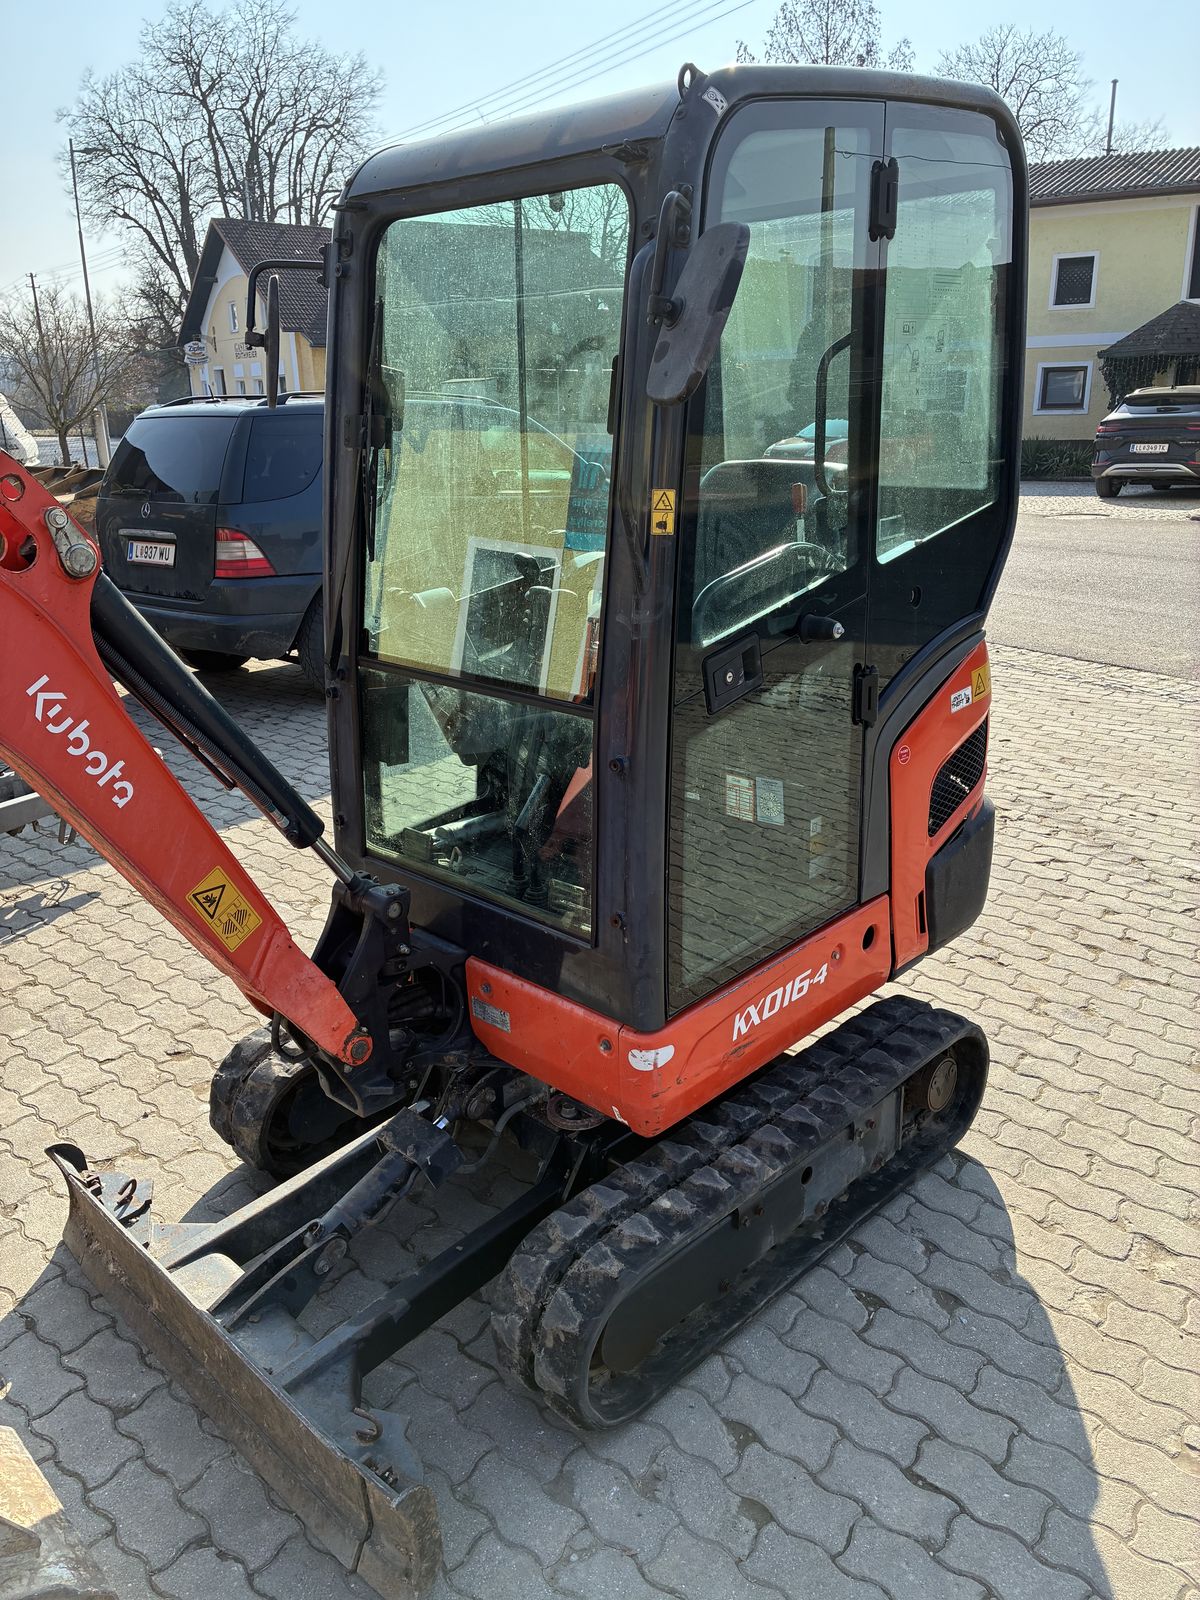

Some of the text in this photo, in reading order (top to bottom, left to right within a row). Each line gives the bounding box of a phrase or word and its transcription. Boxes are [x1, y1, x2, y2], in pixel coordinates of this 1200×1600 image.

[144, 545, 158, 559] 937
[159, 546, 170, 561] WU
[26, 674, 134, 809] Kubota
[732, 963, 828, 1042] KX016-4
